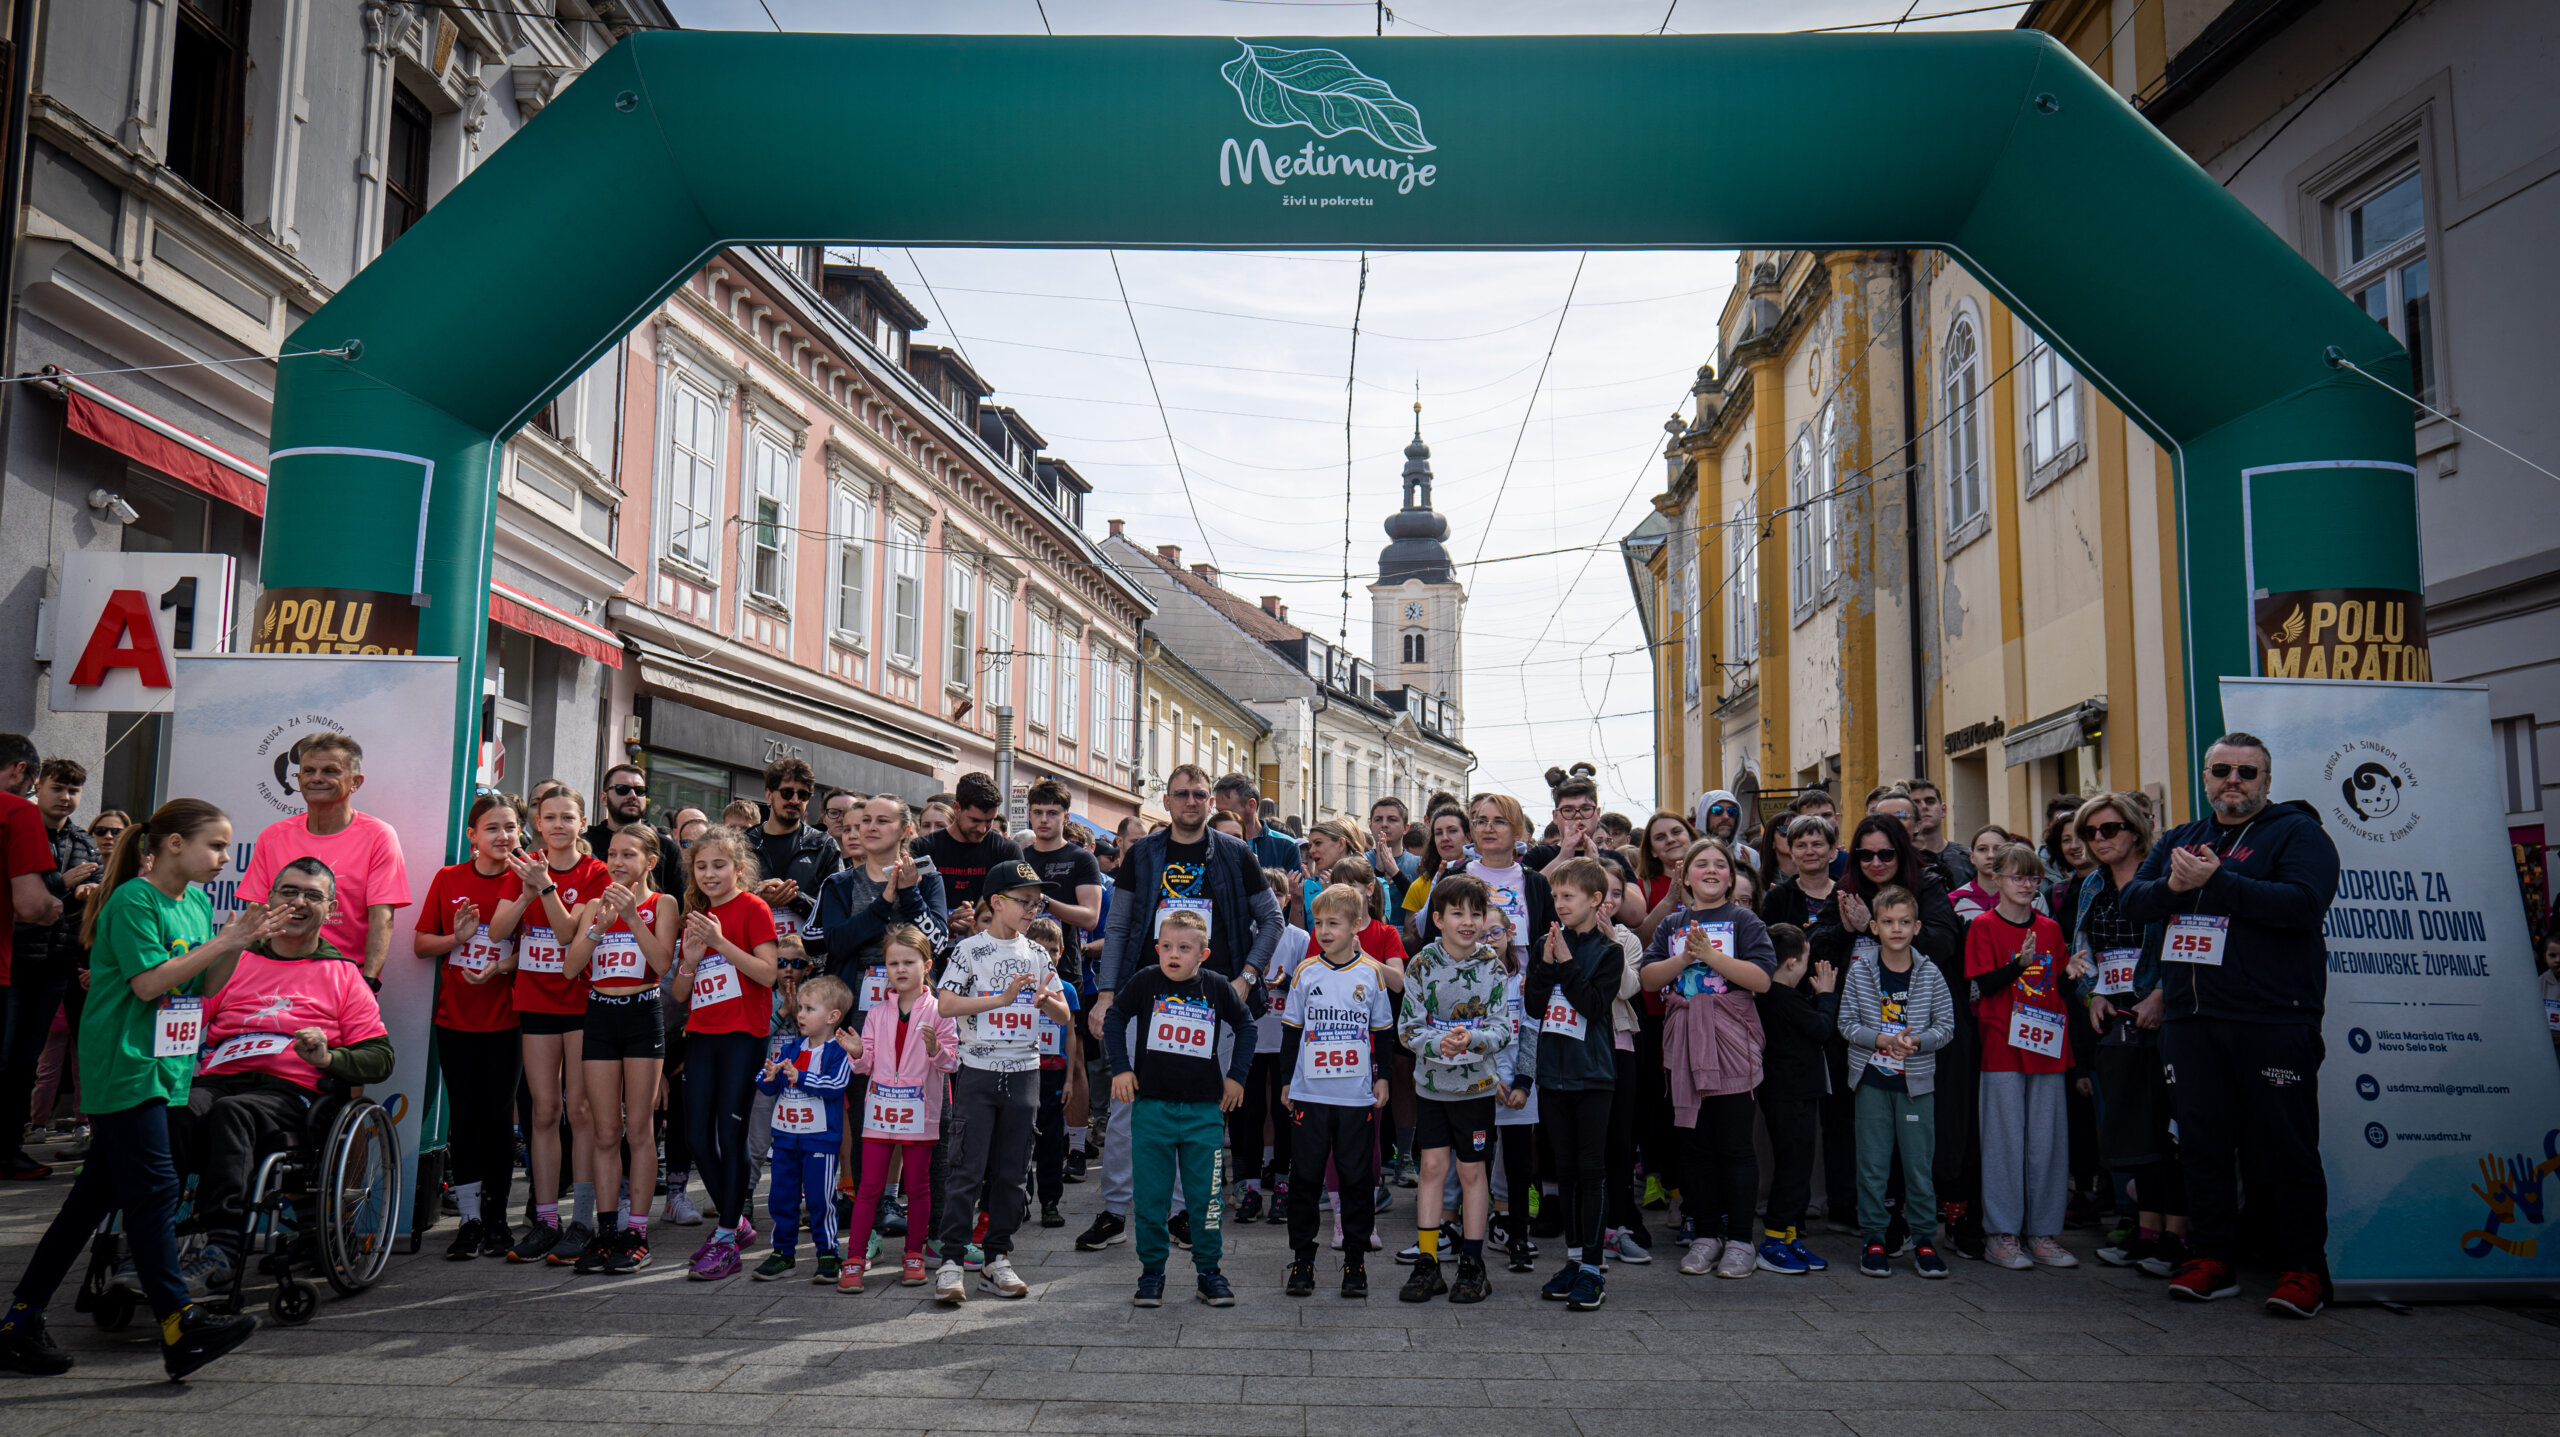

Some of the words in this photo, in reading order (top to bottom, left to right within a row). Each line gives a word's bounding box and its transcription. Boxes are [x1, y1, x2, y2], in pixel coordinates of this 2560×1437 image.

[1219, 138, 1437, 195] Međimurje
[1282, 195, 1307, 206] živi
[1309, 197, 1318, 206] u
[1320, 196, 1374, 208] pokretu
[275, 599, 372, 643] POLU
[2308, 600, 2405, 645] POLU
[69, 576, 197, 688] A1
[2266, 644, 2433, 682] MARATON
[257, 725, 285, 756] UDRUGA
[288, 717, 301, 728] ZA
[306, 714, 345, 734] SINDROM
[2324, 751, 2343, 781] UDRUGA
[2342, 742, 2356, 753] ZA
[2360, 740, 2398, 761] SINDROM
[2399, 761, 2419, 788] DOWN
[256, 781, 305, 816] MEĐIMURSKE
[2332, 807, 2385, 843] MEĐIMURSKE
[2390, 811, 2421, 842] ŽUPANIJE
[2337, 869, 2419, 902] UDRUGA
[2421, 872, 2451, 902] ZA
[775, 921, 797, 935] 51
[914, 911, 949, 956] didas
[2322, 907, 2415, 940] SINDROM
[2418, 910, 2488, 941] DOWN
[460, 942, 501, 962] 175
[2172, 934, 2213, 953] 255
[528, 945, 566, 963] 421
[597, 951, 637, 969] 420
[2326, 951, 2421, 975] MEĐIMURSKE
[2422, 949, 2491, 976] ŽUPANIJE
[693, 973, 727, 997] 407
[2104, 967, 2134, 985] 288
[598, 995, 631, 1006] PRO
[638, 987, 662, 1004] NIK
[1268, 997, 1286, 1011] 28
[988, 1012, 1032, 1030] 494
[1307, 1005, 1368, 1025] Emirates
[166, 1021, 198, 1042] 483
[1157, 1023, 1206, 1047] 008
[2018, 1023, 2055, 1045] 287
[2376, 1030, 2401, 1040] Ulica
[2403, 1031, 2445, 1041] Maršala
[2445, 1032, 2466, 1041] Tita
[2467, 1032, 2483, 1043] 49,
[224, 1039, 274, 1057] 216
[2379, 1042, 2405, 1052] Novo
[2406, 1042, 2428, 1052] Selo
[2429, 1043, 2448, 1053] Rok
[1314, 1049, 1359, 1067] 268
[2261, 1070, 2303, 1082] ORIGINAL
[2267, 1067, 2294, 1076] VINSON
[2386, 1083, 2510, 1097] usdmz.mail@gmail.com
[776, 1104, 815, 1123] 163
[872, 1104, 914, 1124] 162
[2396, 1132, 2473, 1142] www.usdmz.hr
[1211, 1148, 1223, 1196] URBAN
